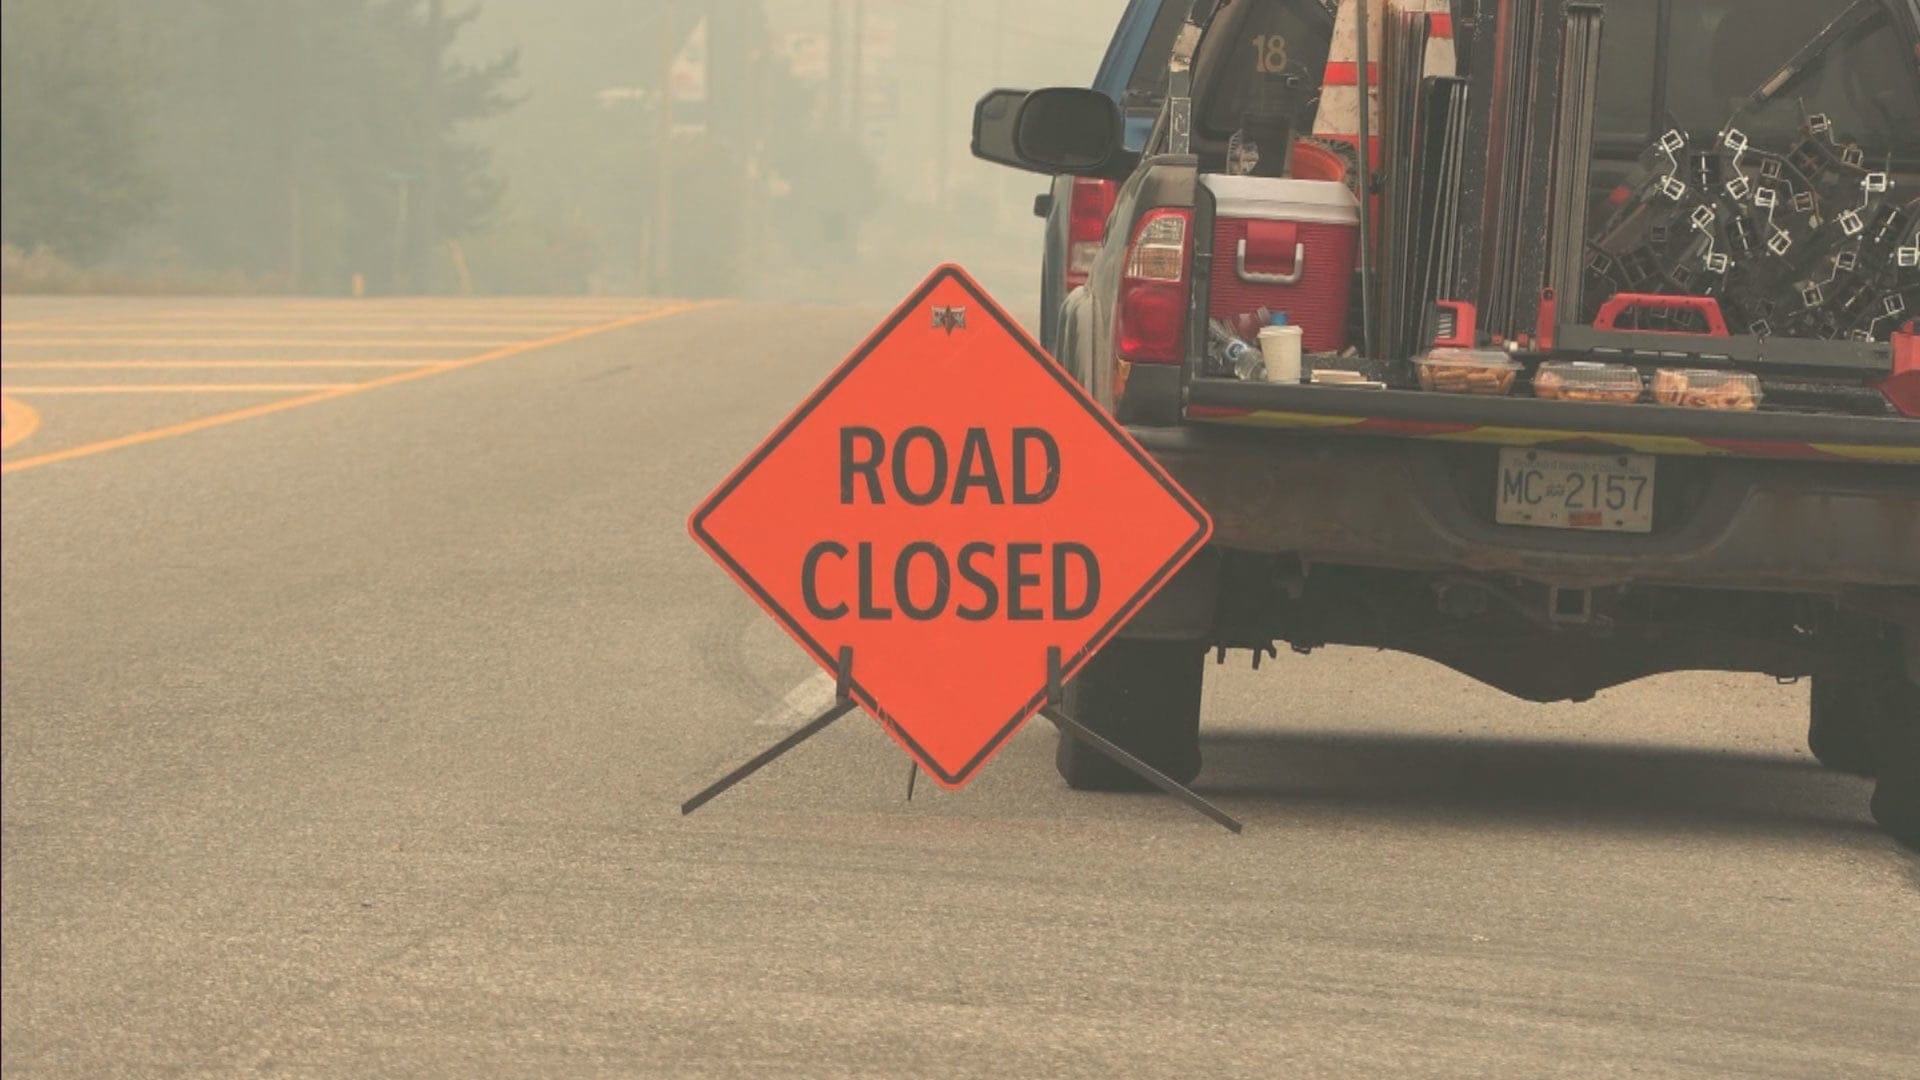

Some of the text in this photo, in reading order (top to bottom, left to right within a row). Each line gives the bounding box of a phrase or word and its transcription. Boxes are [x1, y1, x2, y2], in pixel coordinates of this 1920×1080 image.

[1252, 34, 1288, 73] 18
[839, 426, 1061, 505] ROAD
[1502, 468, 1648, 511] MC 2157
[801, 541, 1101, 621] CLOSED
